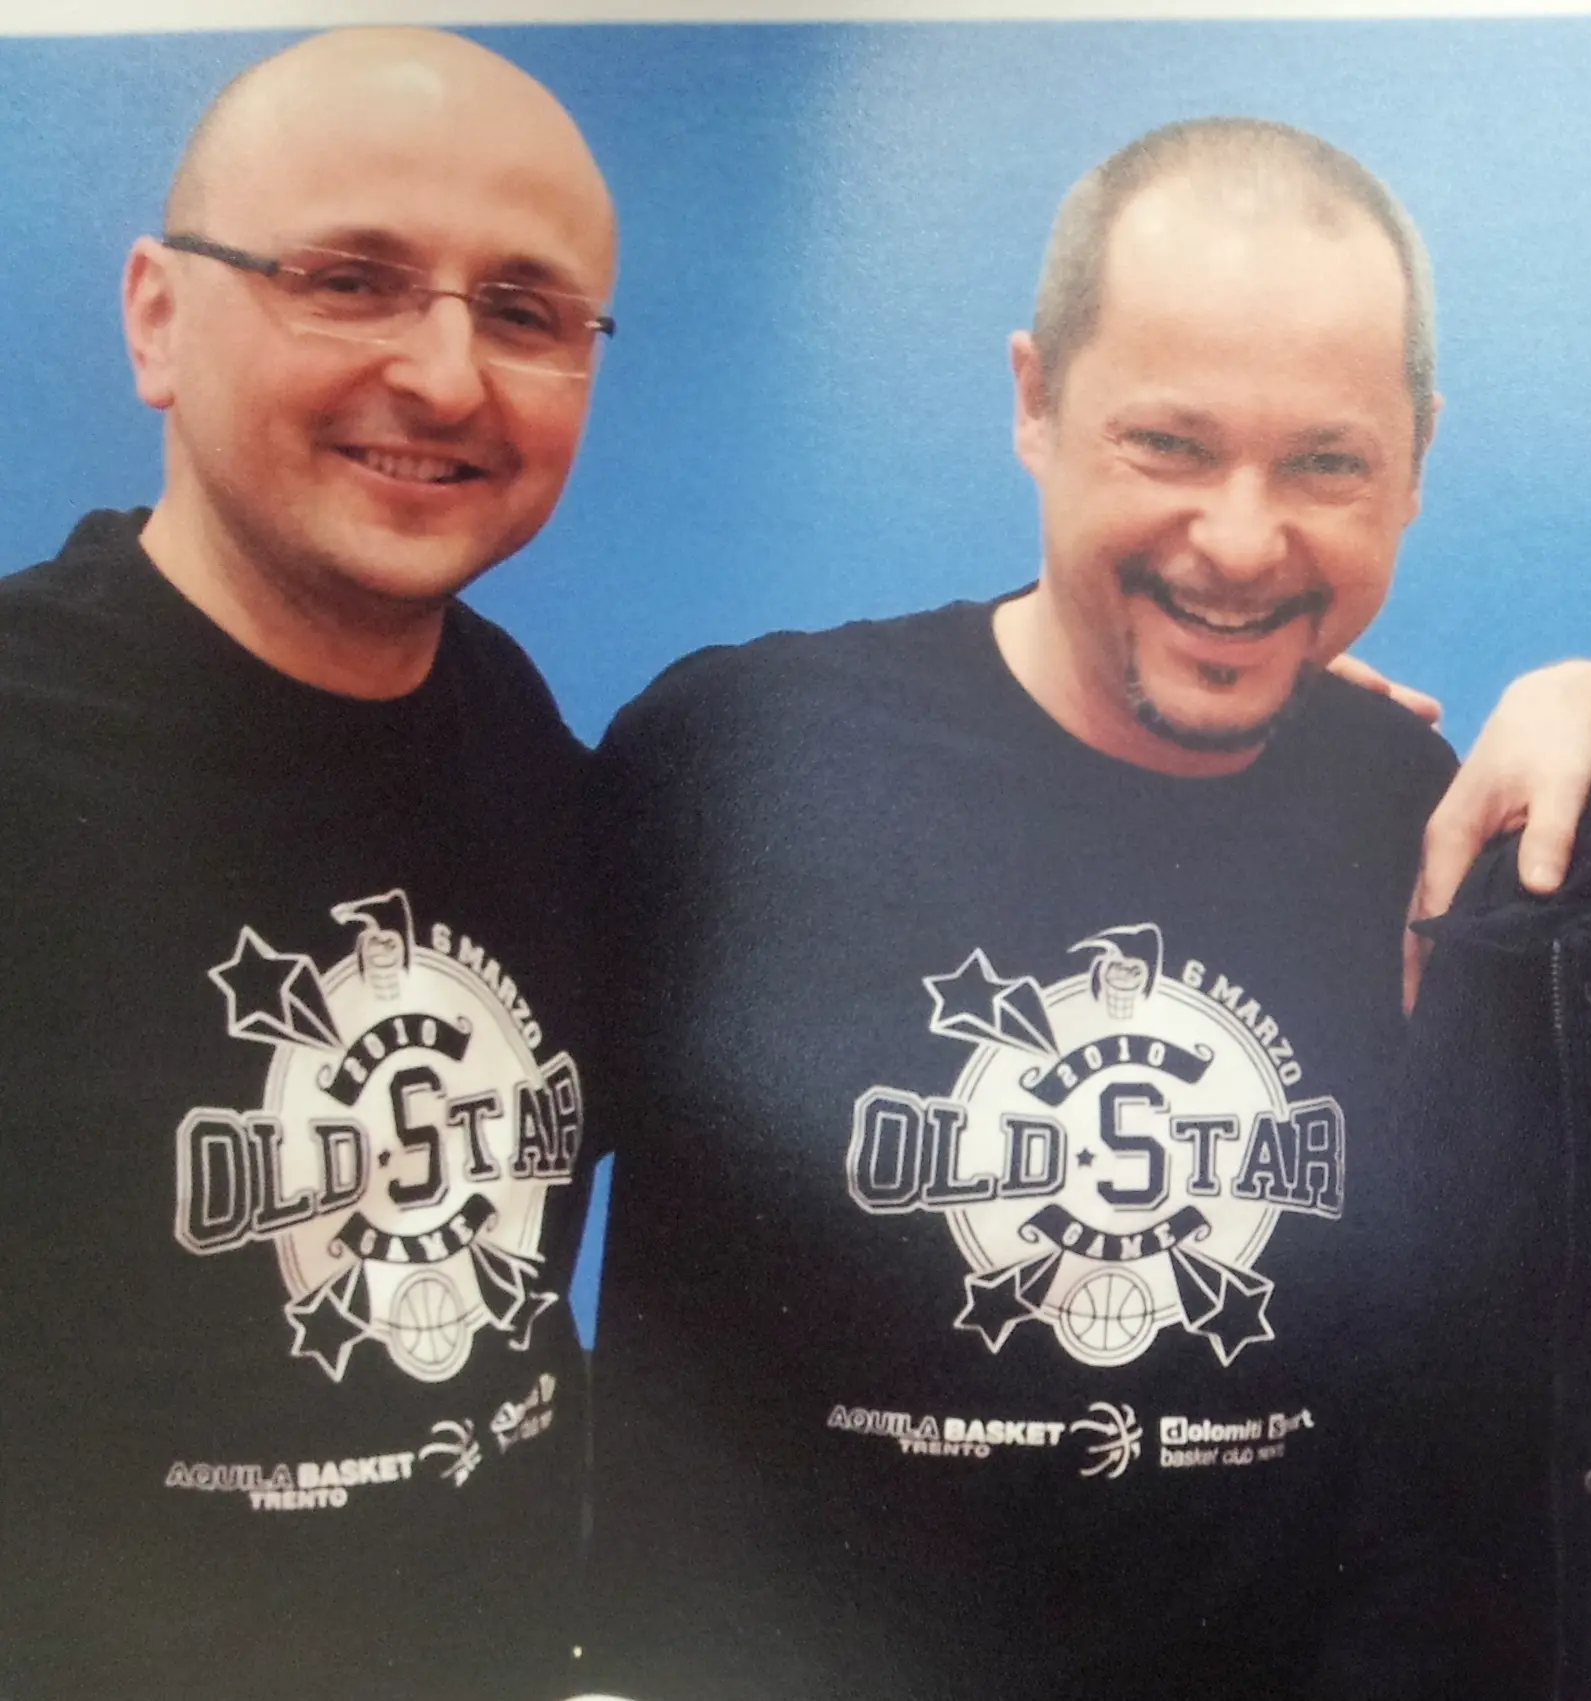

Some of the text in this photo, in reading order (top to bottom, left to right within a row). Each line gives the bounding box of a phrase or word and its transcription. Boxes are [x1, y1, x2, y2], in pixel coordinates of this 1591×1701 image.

[432, 922, 544, 1050] 6 MARZO
[1181, 959, 1303, 1087] 6 MARZO
[344, 1017, 438, 1083] 2010
[1055, 1038, 1167, 1088] 2010
[845, 1081, 1345, 1220] OLD STAR
[174, 1106, 371, 1256] OLD
[359, 1217, 476, 1262] GAME
[1060, 1221, 1178, 1261] GAME
[828, 1404, 1065, 1446] AQUILA BASKET
[898, 1438, 992, 1459] TRENTO
[165, 1451, 416, 1492] AQUILA BASKET
[248, 1487, 350, 1511] TRENTO
